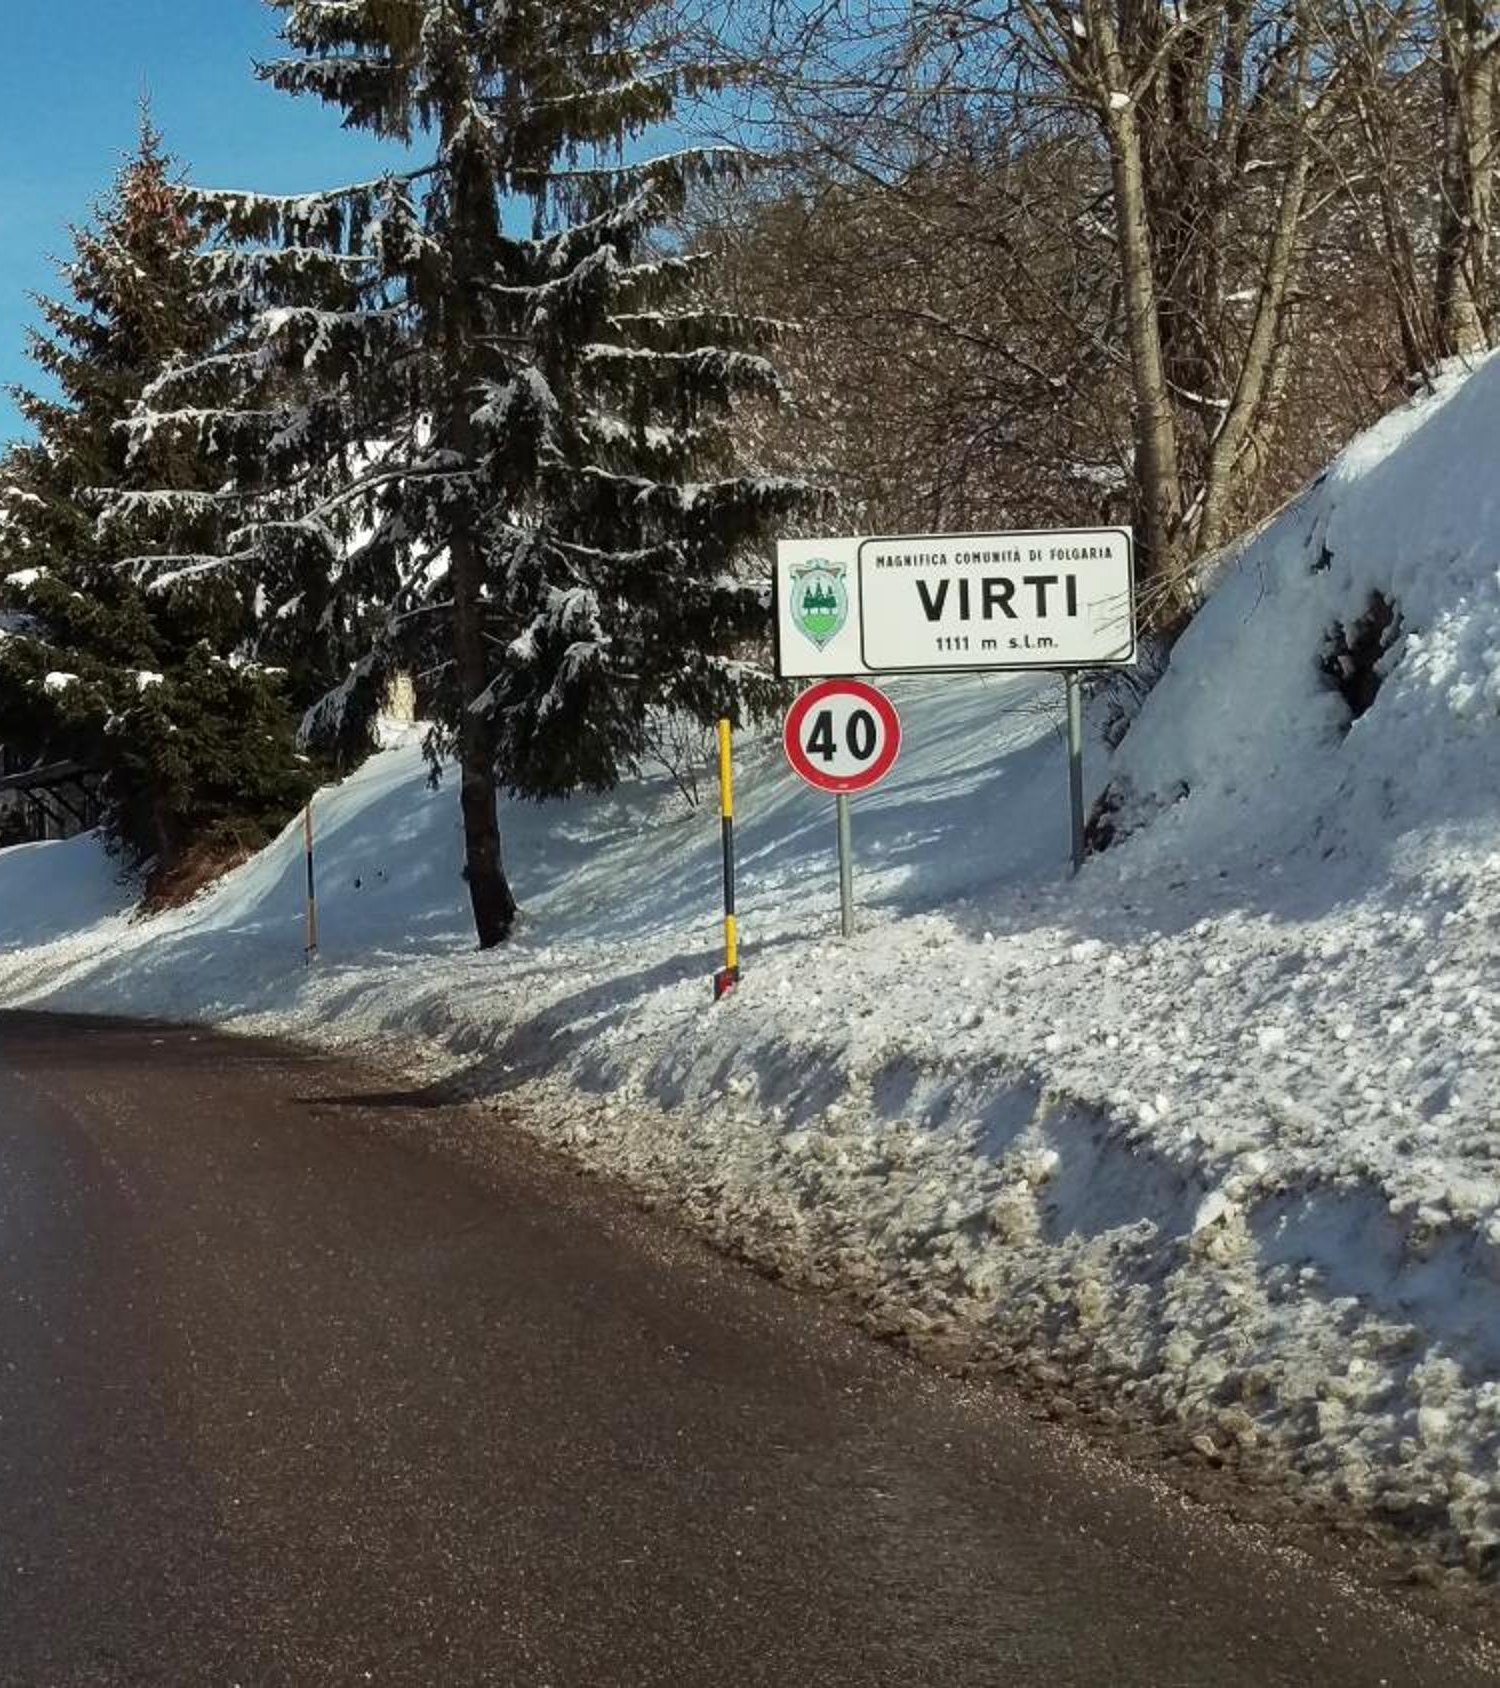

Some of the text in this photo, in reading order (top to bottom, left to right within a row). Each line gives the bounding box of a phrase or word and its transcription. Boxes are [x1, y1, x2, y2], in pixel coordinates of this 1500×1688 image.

[876, 546, 1113, 568] MAGNIFICA COMUNITÀ DI FOLGARIA
[915, 574, 1077, 622] VIRTI
[936, 634, 1059, 650] 1111 m s.l.m.
[806, 709, 877, 761] 40
